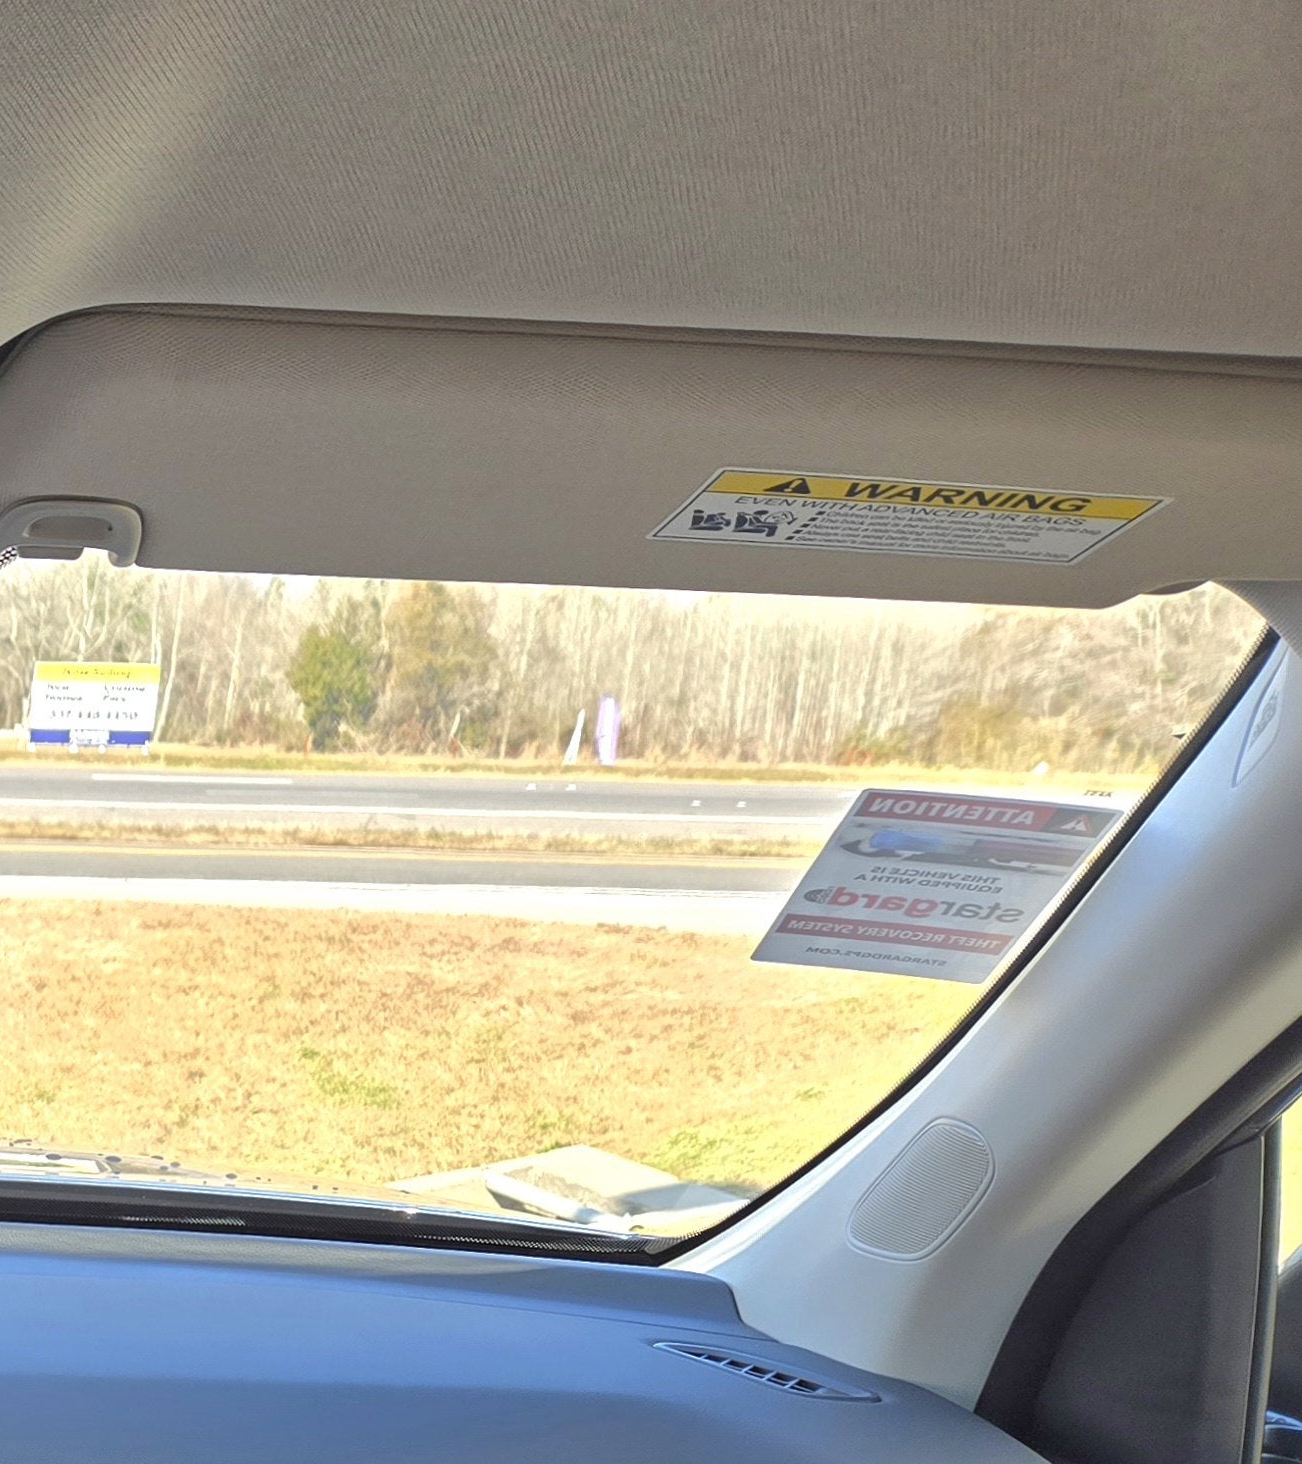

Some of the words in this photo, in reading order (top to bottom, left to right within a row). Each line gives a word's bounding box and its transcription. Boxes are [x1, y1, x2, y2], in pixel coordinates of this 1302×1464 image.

[734, 495, 797, 507] EVEN
[801, 500, 859, 511] WITH
[858, 503, 979, 519] ADVANCED
[981, 512, 1020, 522] AIR
[1022, 514, 1087, 526] BAGS
[845, 482, 1092, 512] WARNING
